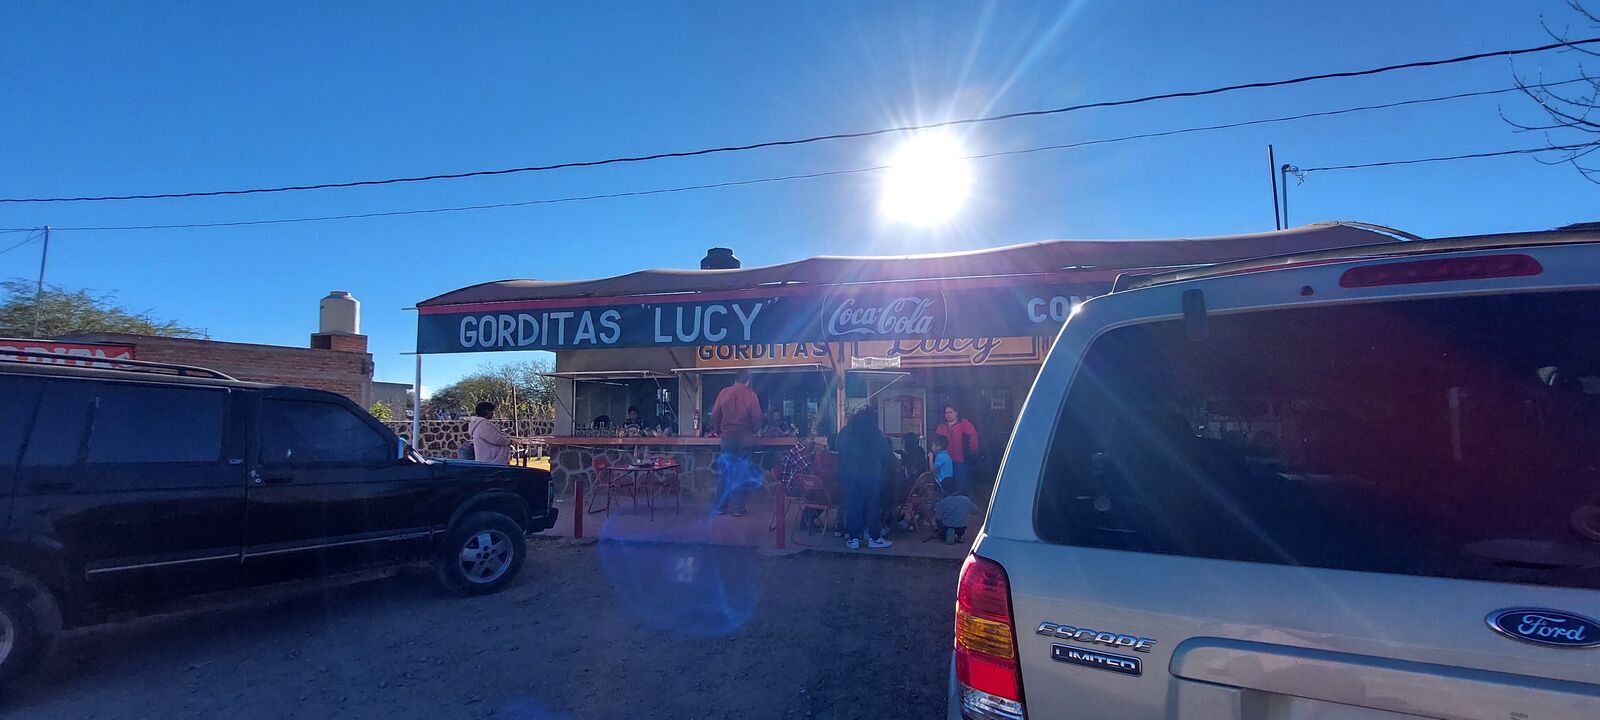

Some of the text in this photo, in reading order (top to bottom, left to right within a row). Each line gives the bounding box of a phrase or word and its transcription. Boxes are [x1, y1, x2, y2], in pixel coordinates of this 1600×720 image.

[459, 309, 622, 348] GORDITAS
[828, 297, 937, 336] Coca-Cola
[697, 341, 829, 361] GORDITAS
[1036, 621, 1158, 653] ESCAPE
[1518, 614, 1586, 641] Ford
[1055, 648, 1137, 671] LIMITED
